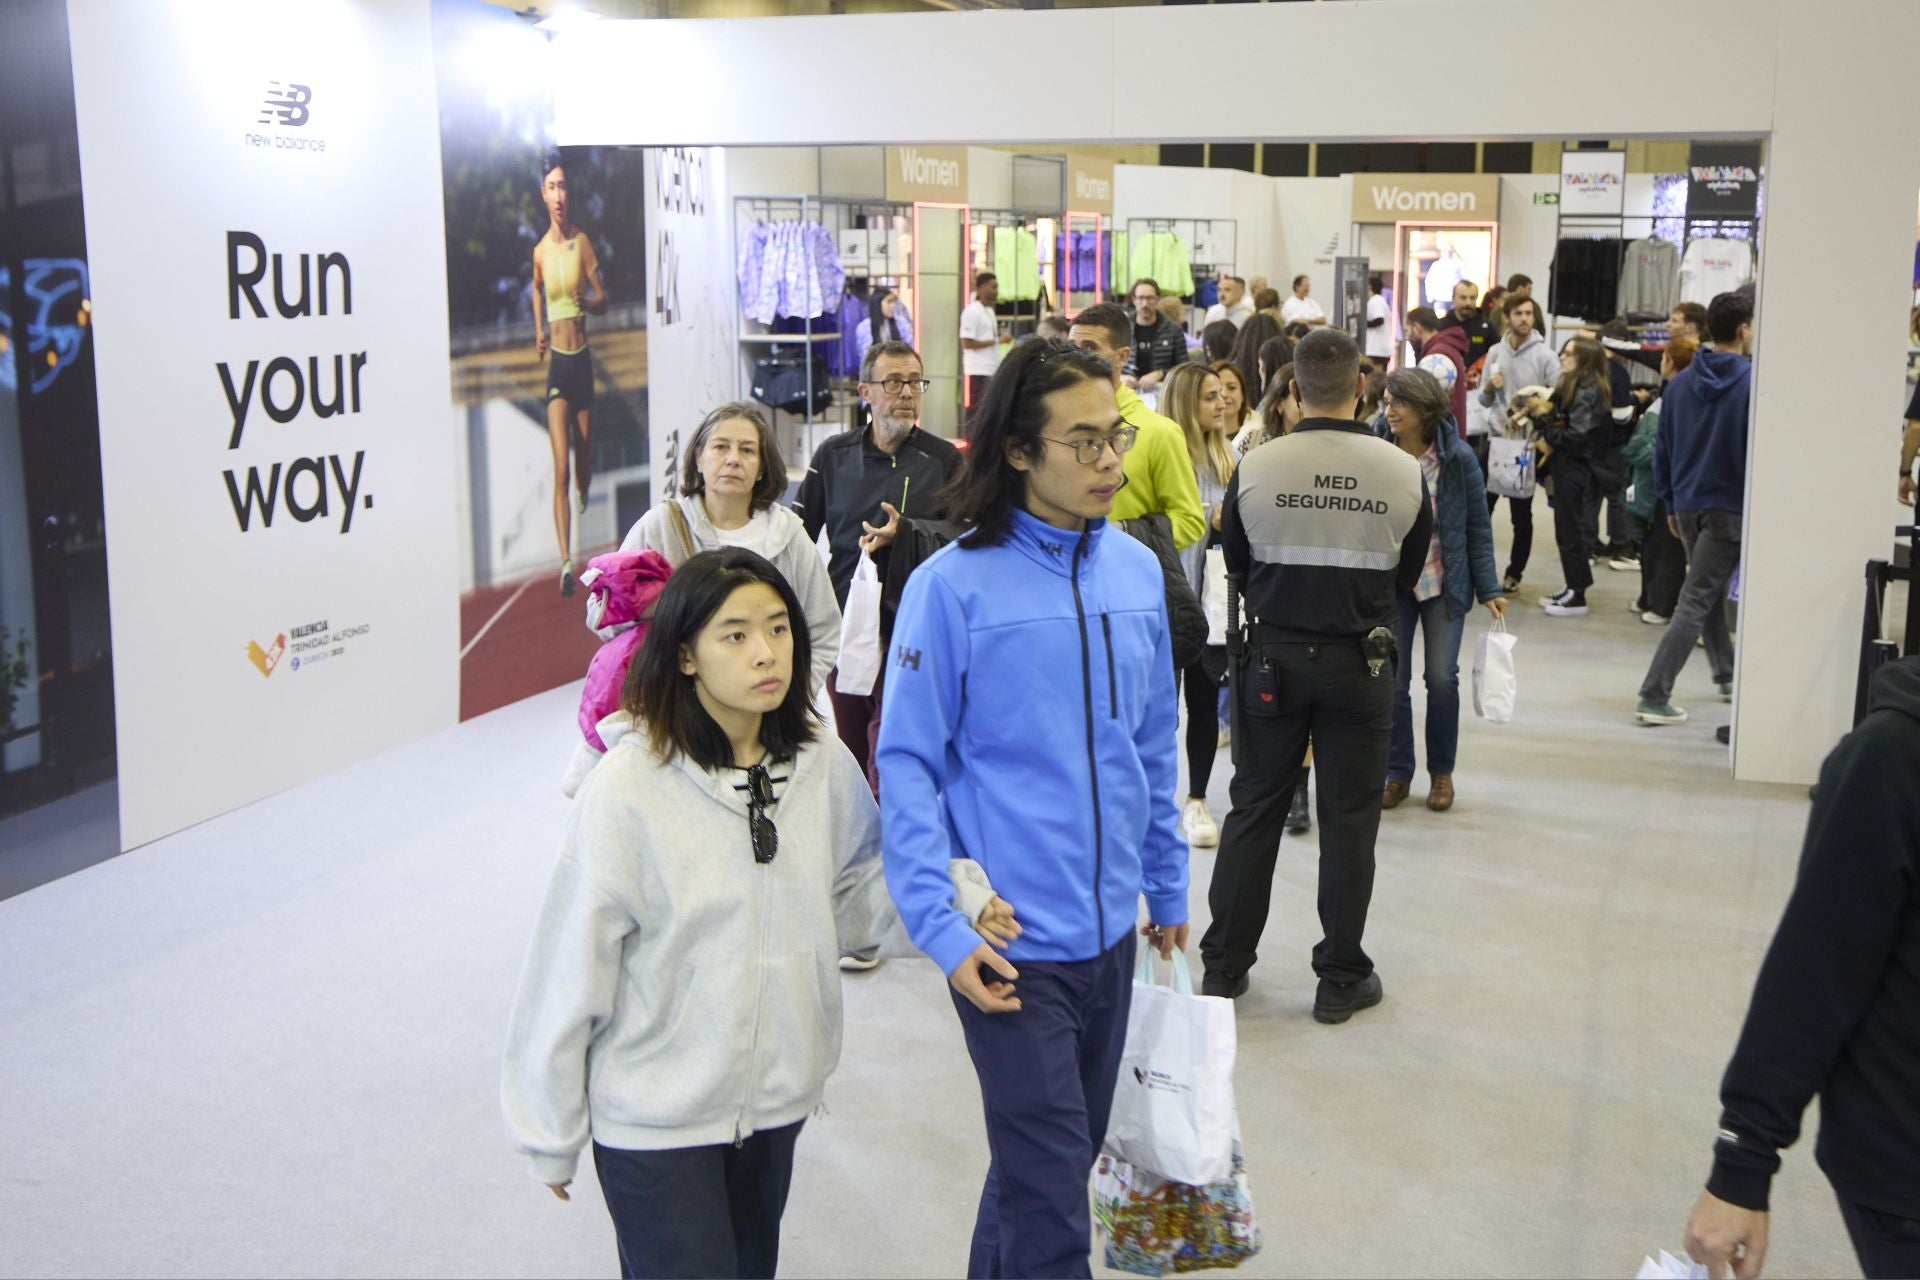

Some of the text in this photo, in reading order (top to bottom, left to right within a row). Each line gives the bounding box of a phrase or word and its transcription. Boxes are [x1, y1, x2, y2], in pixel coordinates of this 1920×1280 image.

[245, 133, 326, 152] new balance
[900, 148, 959, 186] Women
[1075, 170, 1110, 200] Women
[1371, 186, 1476, 211] Women
[226, 231, 352, 319] Run
[655, 229, 682, 328] 42K
[216, 351, 367, 450] your
[222, 450, 373, 534] way.
[1314, 474, 1358, 490] MED
[1275, 493, 1389, 515] SEGURIDAD
[290, 620, 328, 639] VALENCIA
